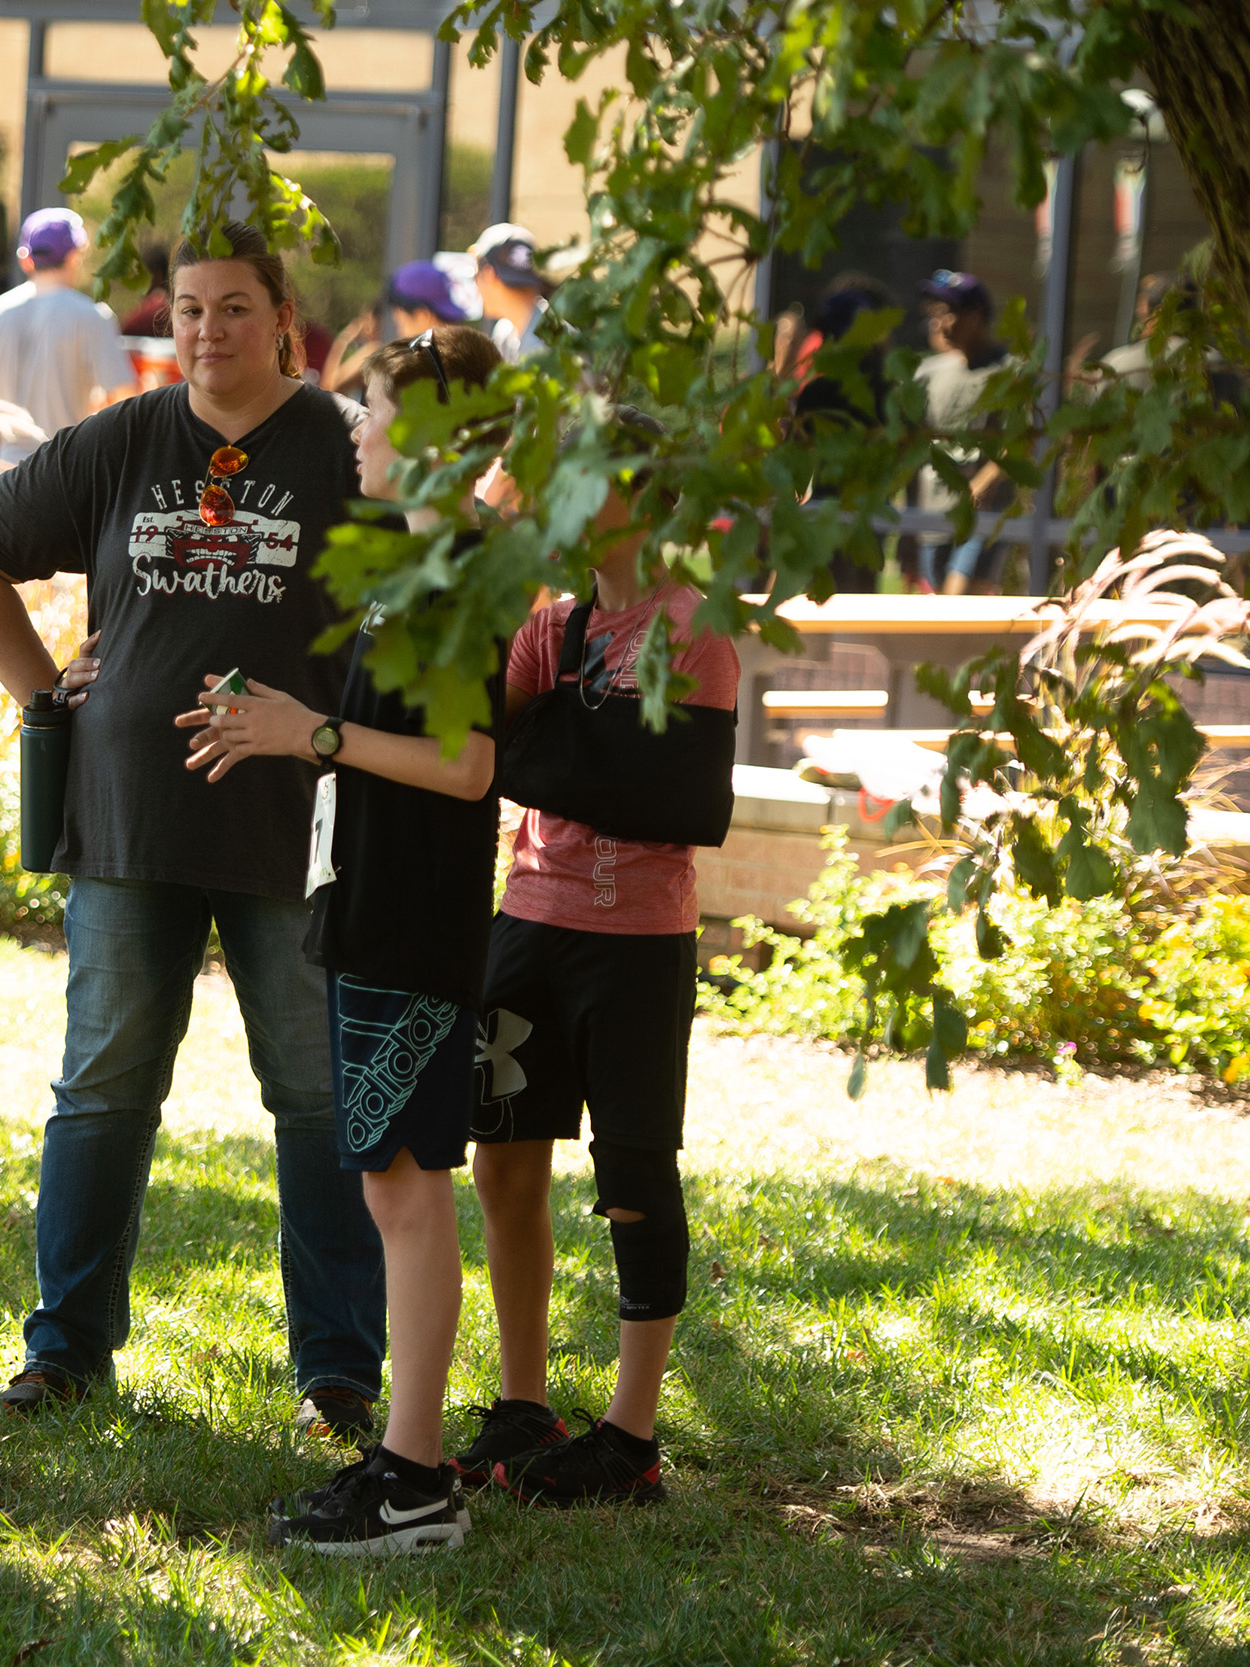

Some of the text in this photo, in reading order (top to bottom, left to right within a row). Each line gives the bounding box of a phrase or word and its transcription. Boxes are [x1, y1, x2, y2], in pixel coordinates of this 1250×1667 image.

[135, 525, 293, 552] 19 54
[184, 524, 249, 535] HESSTON
[133, 552, 287, 604] Swathers
[592, 834, 617, 907] OUR
